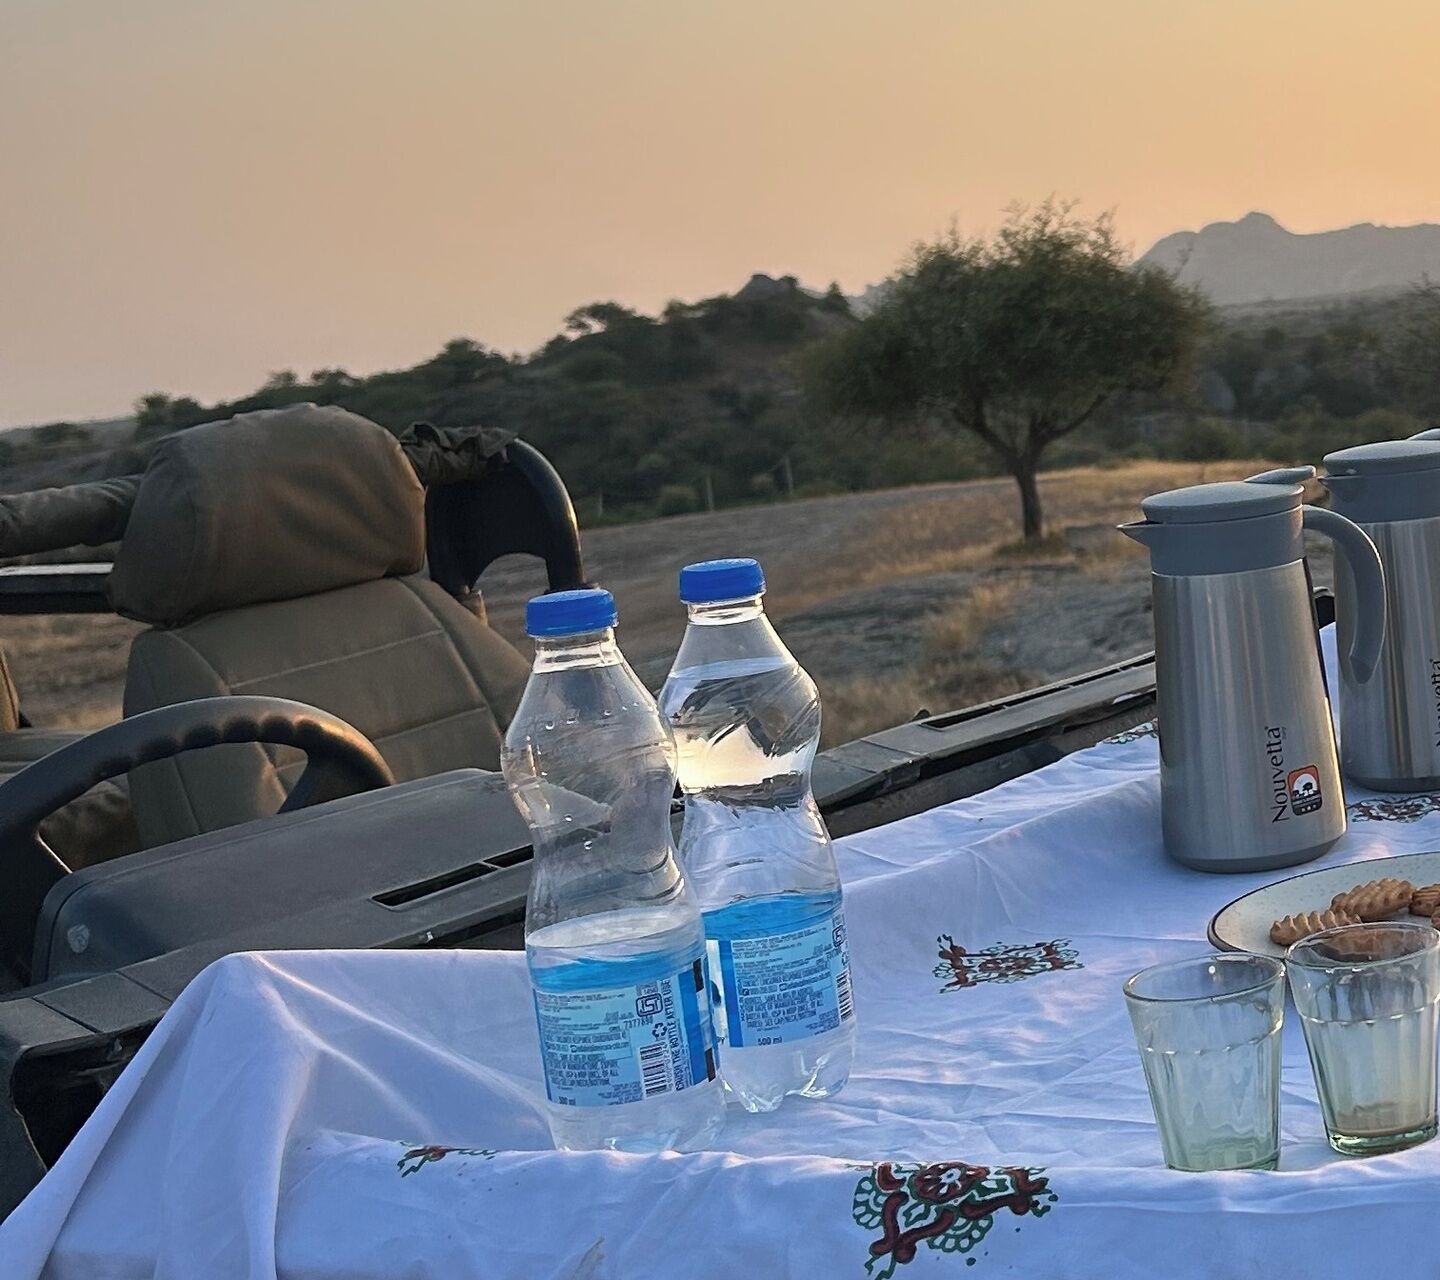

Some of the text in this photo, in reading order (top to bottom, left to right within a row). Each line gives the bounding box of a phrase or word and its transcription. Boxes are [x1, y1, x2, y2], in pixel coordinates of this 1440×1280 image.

[1265, 726, 1290, 823] Nouvetta
[662, 980, 671, 995] USE
[664, 997, 675, 1019] AFTER
[667, 1021, 679, 1048] BOTTLE
[672, 1050, 681, 1064] THE
